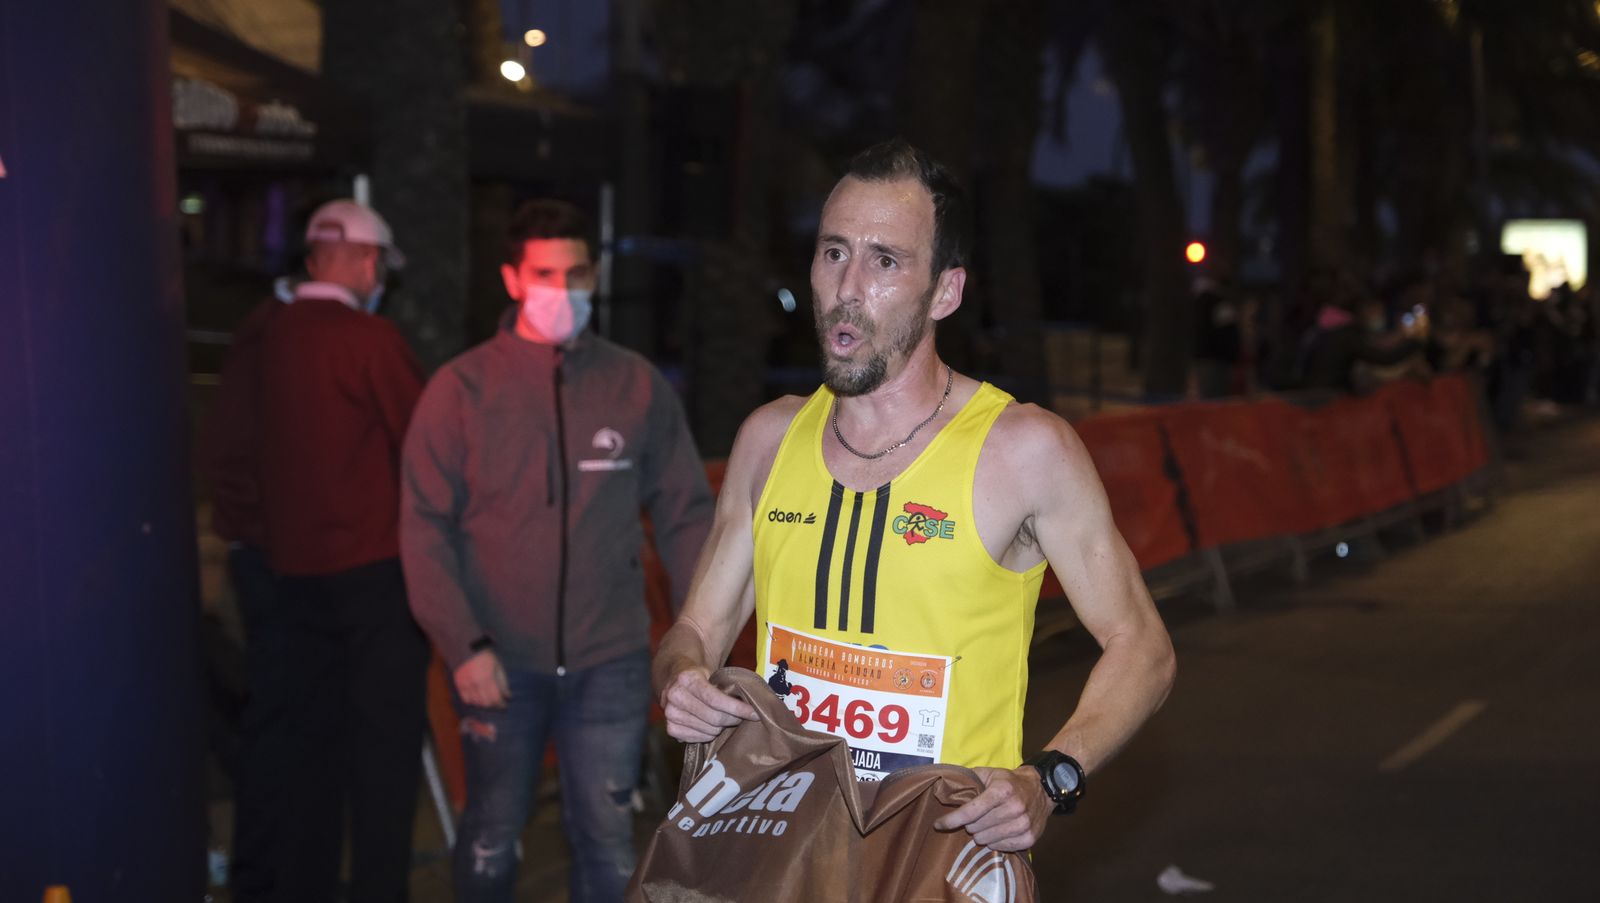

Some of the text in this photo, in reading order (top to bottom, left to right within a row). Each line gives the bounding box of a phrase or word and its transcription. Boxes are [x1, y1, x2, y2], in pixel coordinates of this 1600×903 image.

[768, 508, 802, 524] daen
[797, 641, 894, 669] CARRERA BOMBEROS
[843, 664, 882, 679] CIUDAD
[790, 684, 910, 744] 3469
[850, 749, 881, 770] JADA
